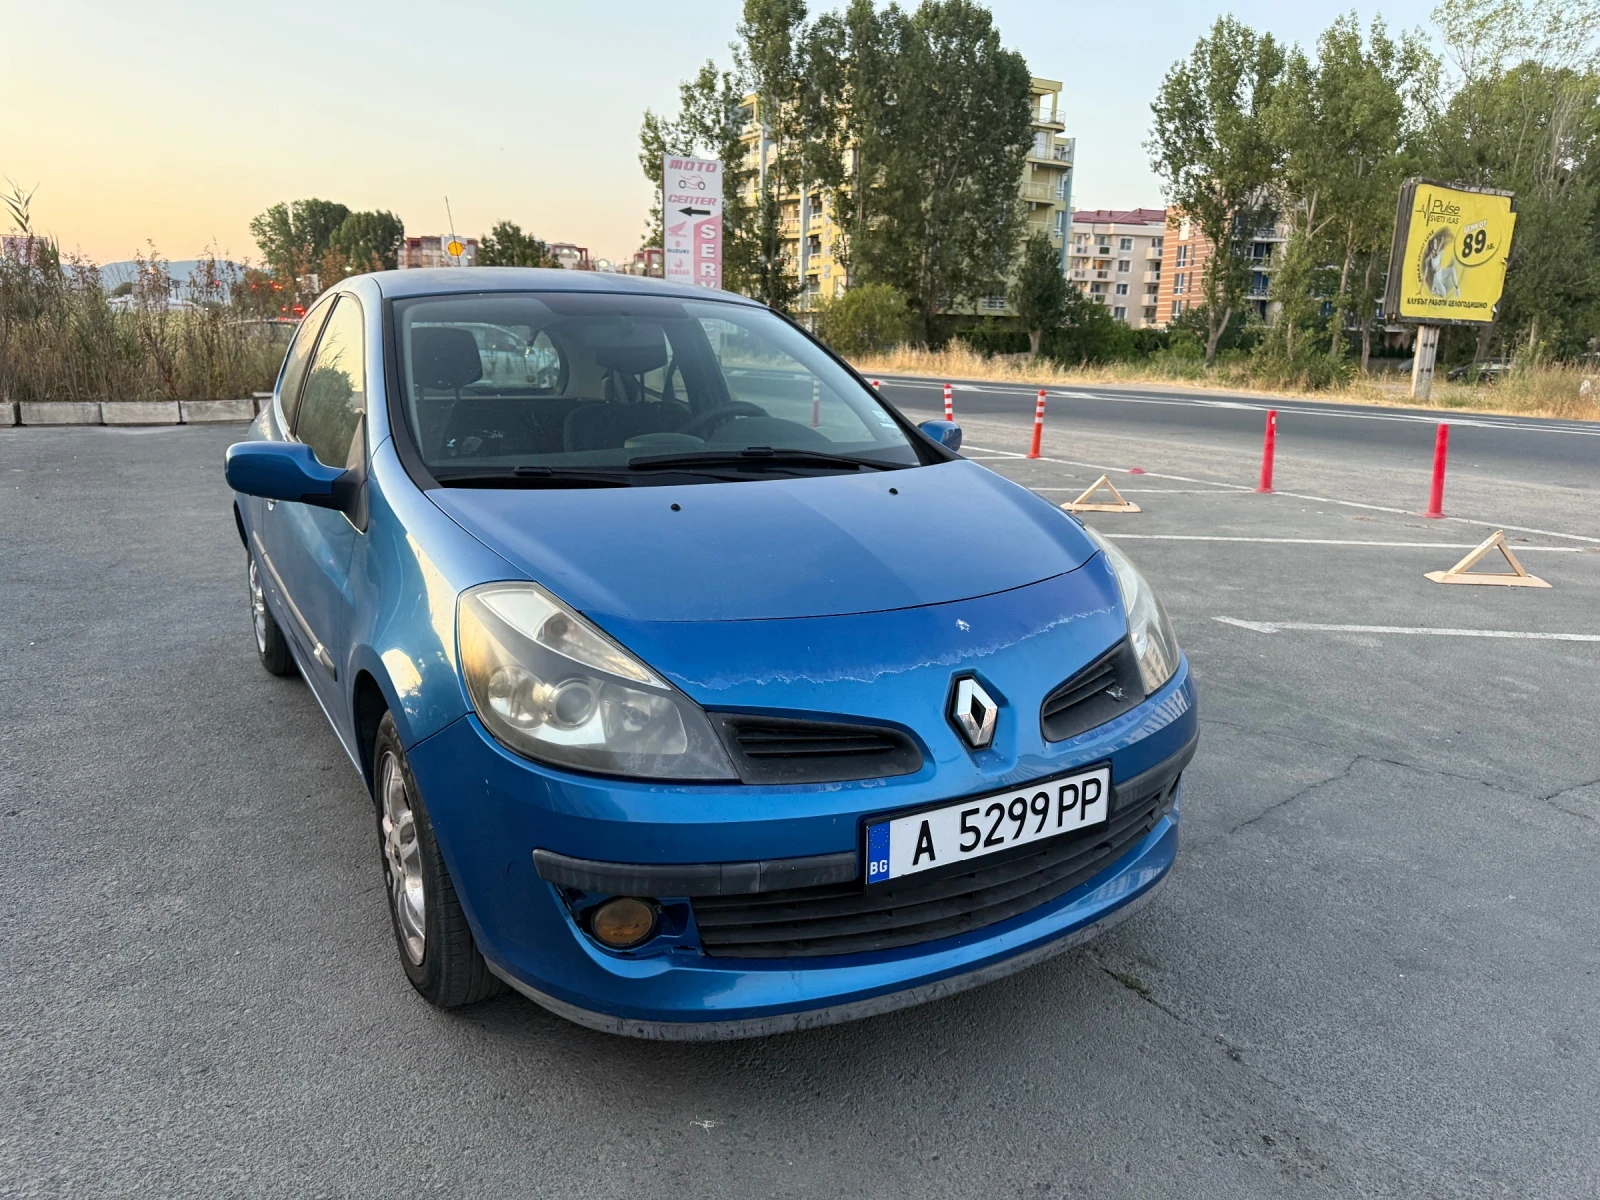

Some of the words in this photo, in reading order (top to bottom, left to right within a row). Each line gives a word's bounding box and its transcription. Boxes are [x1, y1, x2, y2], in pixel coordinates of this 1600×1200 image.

[668, 159, 717, 173] MOTO
[667, 194, 717, 206] CENTER
[1432, 199, 1460, 215] Pulse
[1462, 229, 1487, 258] 89
[869, 859, 888, 876] BG
[912, 820, 936, 866] A
[959, 791, 1050, 853] 5299
[1057, 777, 1102, 828] PP
